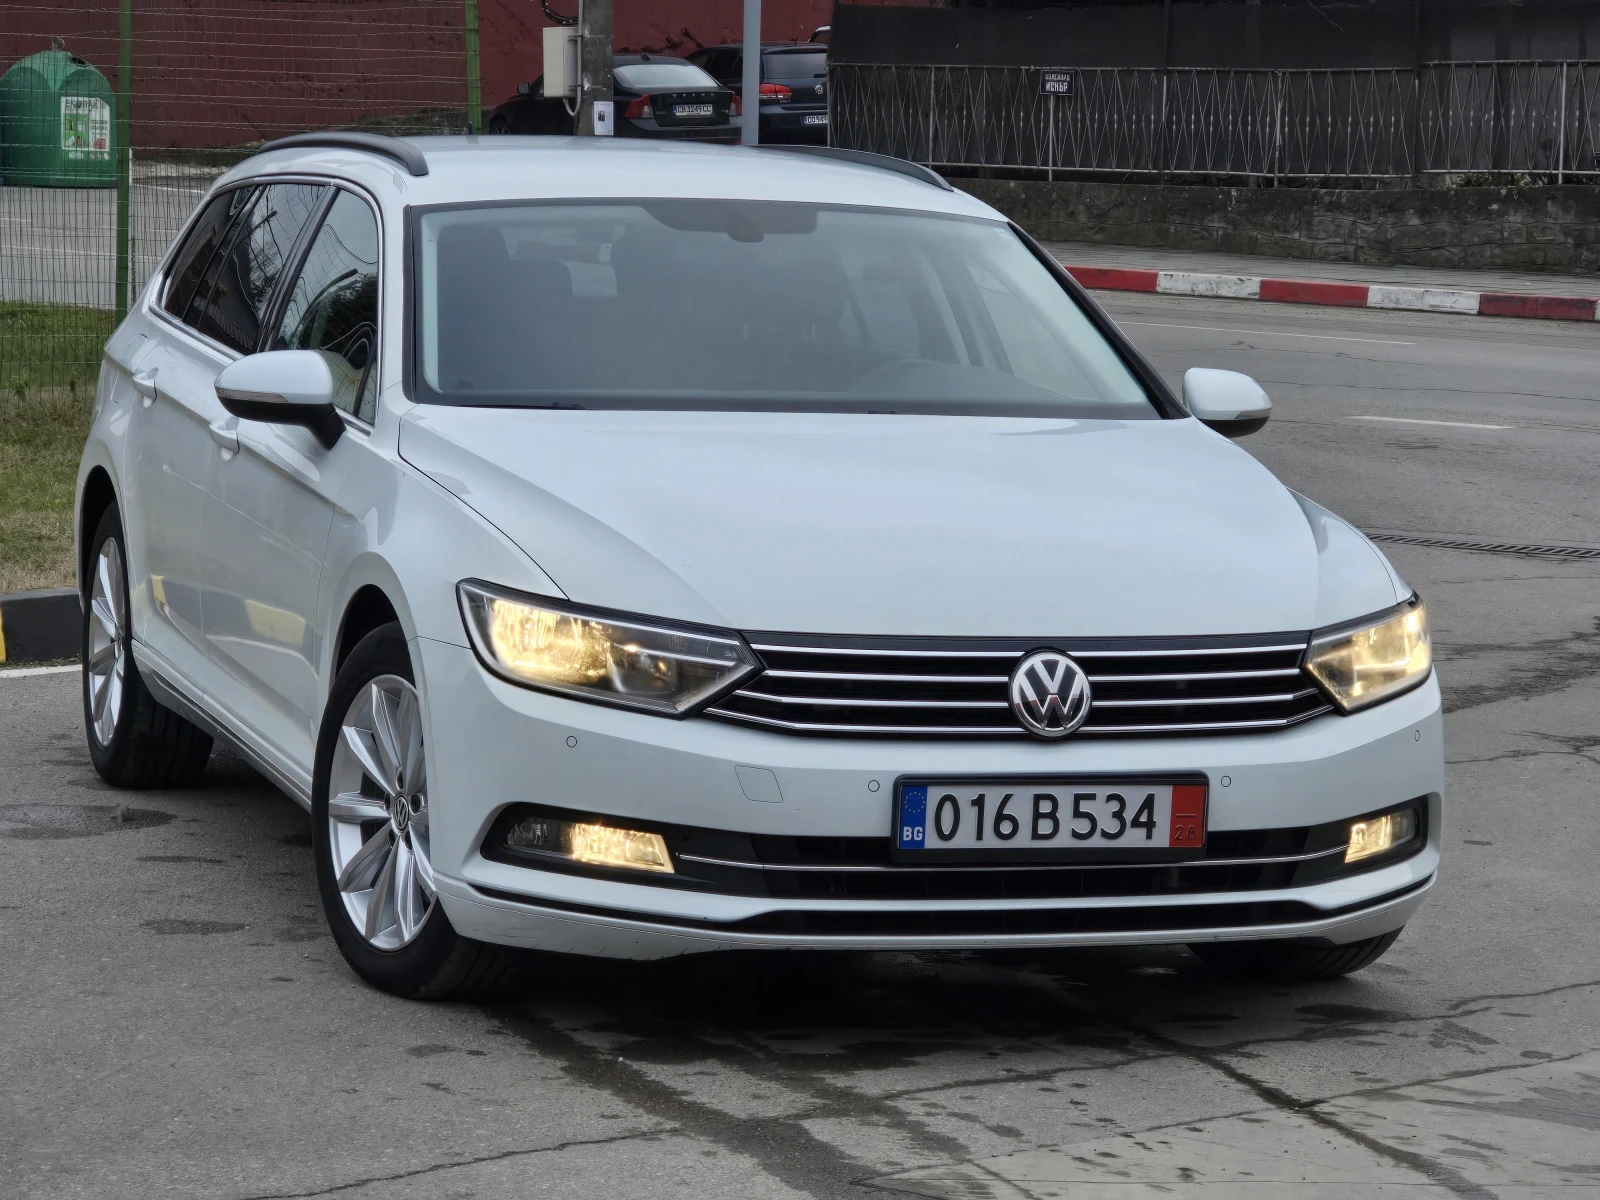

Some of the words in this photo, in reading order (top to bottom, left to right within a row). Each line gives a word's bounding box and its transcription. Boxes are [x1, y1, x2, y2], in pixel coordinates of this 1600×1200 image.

[1045, 81, 1068, 92] ИСКЪР
[1016, 653, 1086, 732] VW
[902, 825, 923, 842] BG
